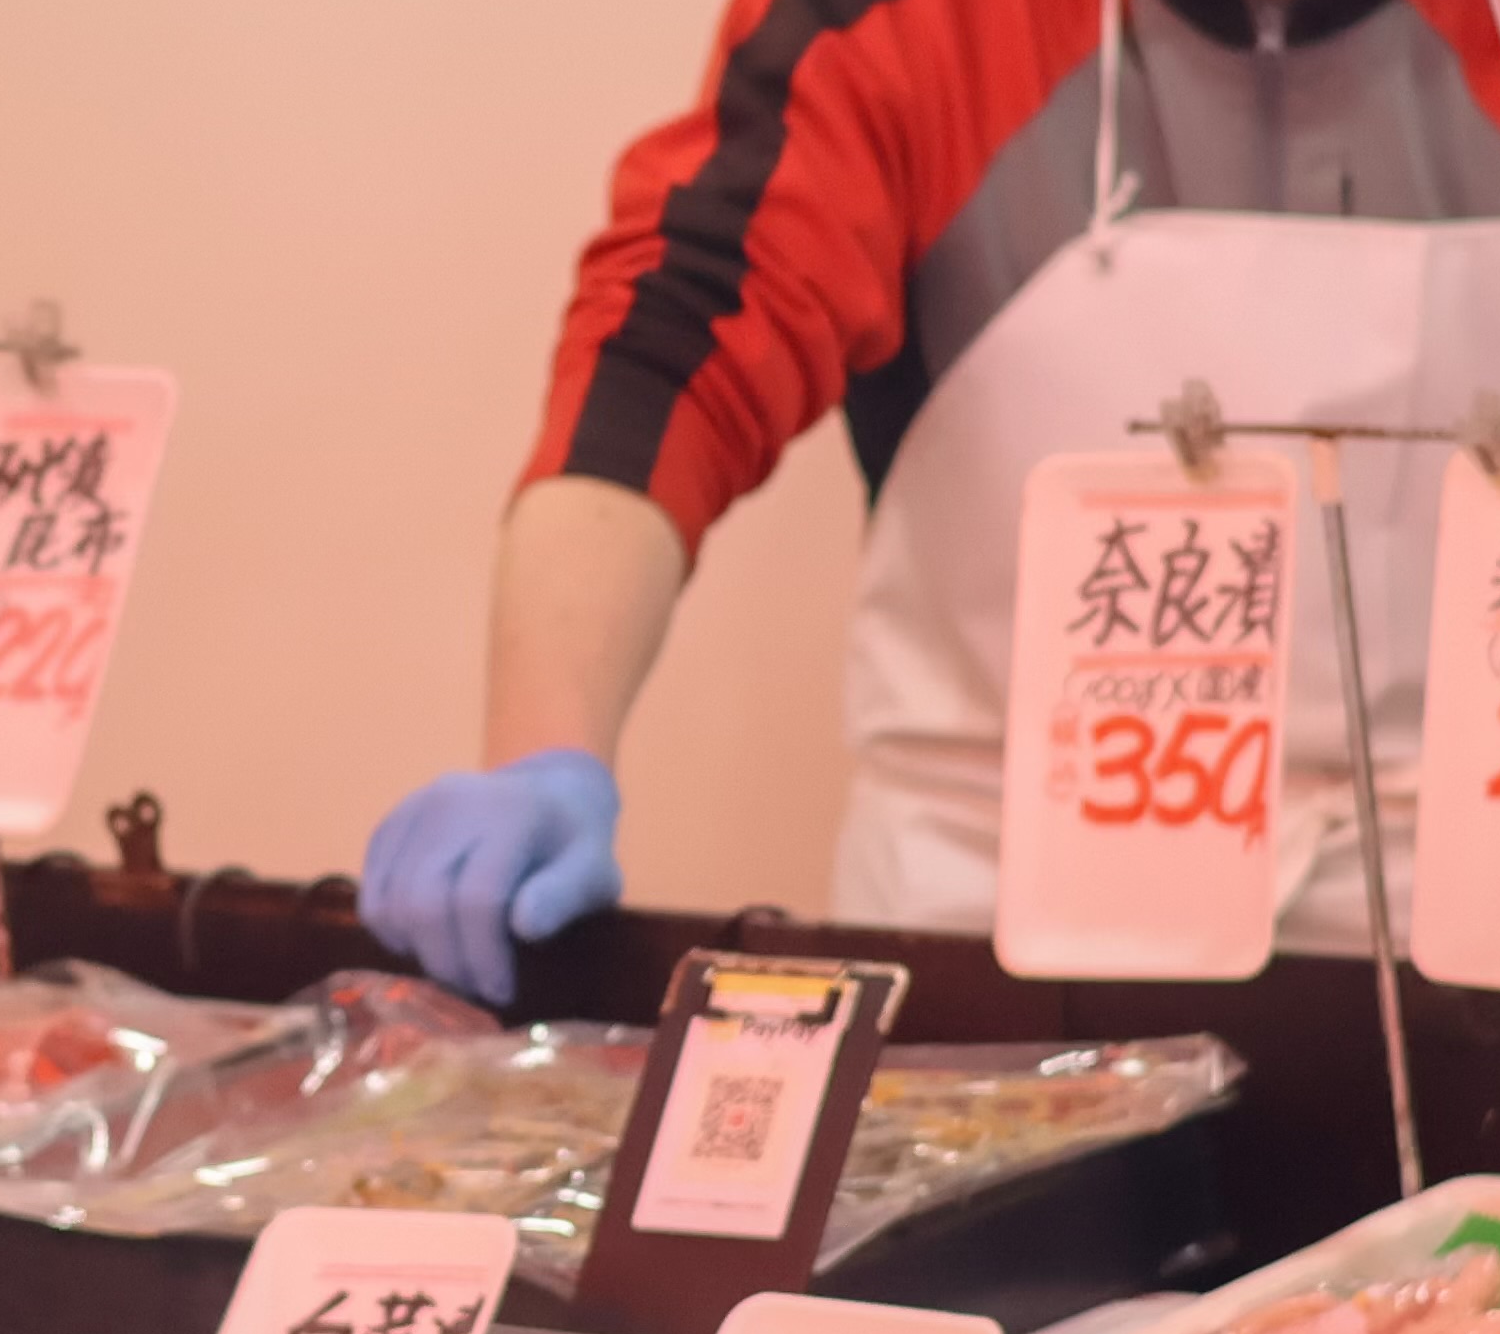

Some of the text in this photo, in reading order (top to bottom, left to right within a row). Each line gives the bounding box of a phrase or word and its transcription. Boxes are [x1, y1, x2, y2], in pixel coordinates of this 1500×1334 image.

[1067, 517, 1282, 647] 奈良漬
[738, 1017, 820, 1045] PayPay
